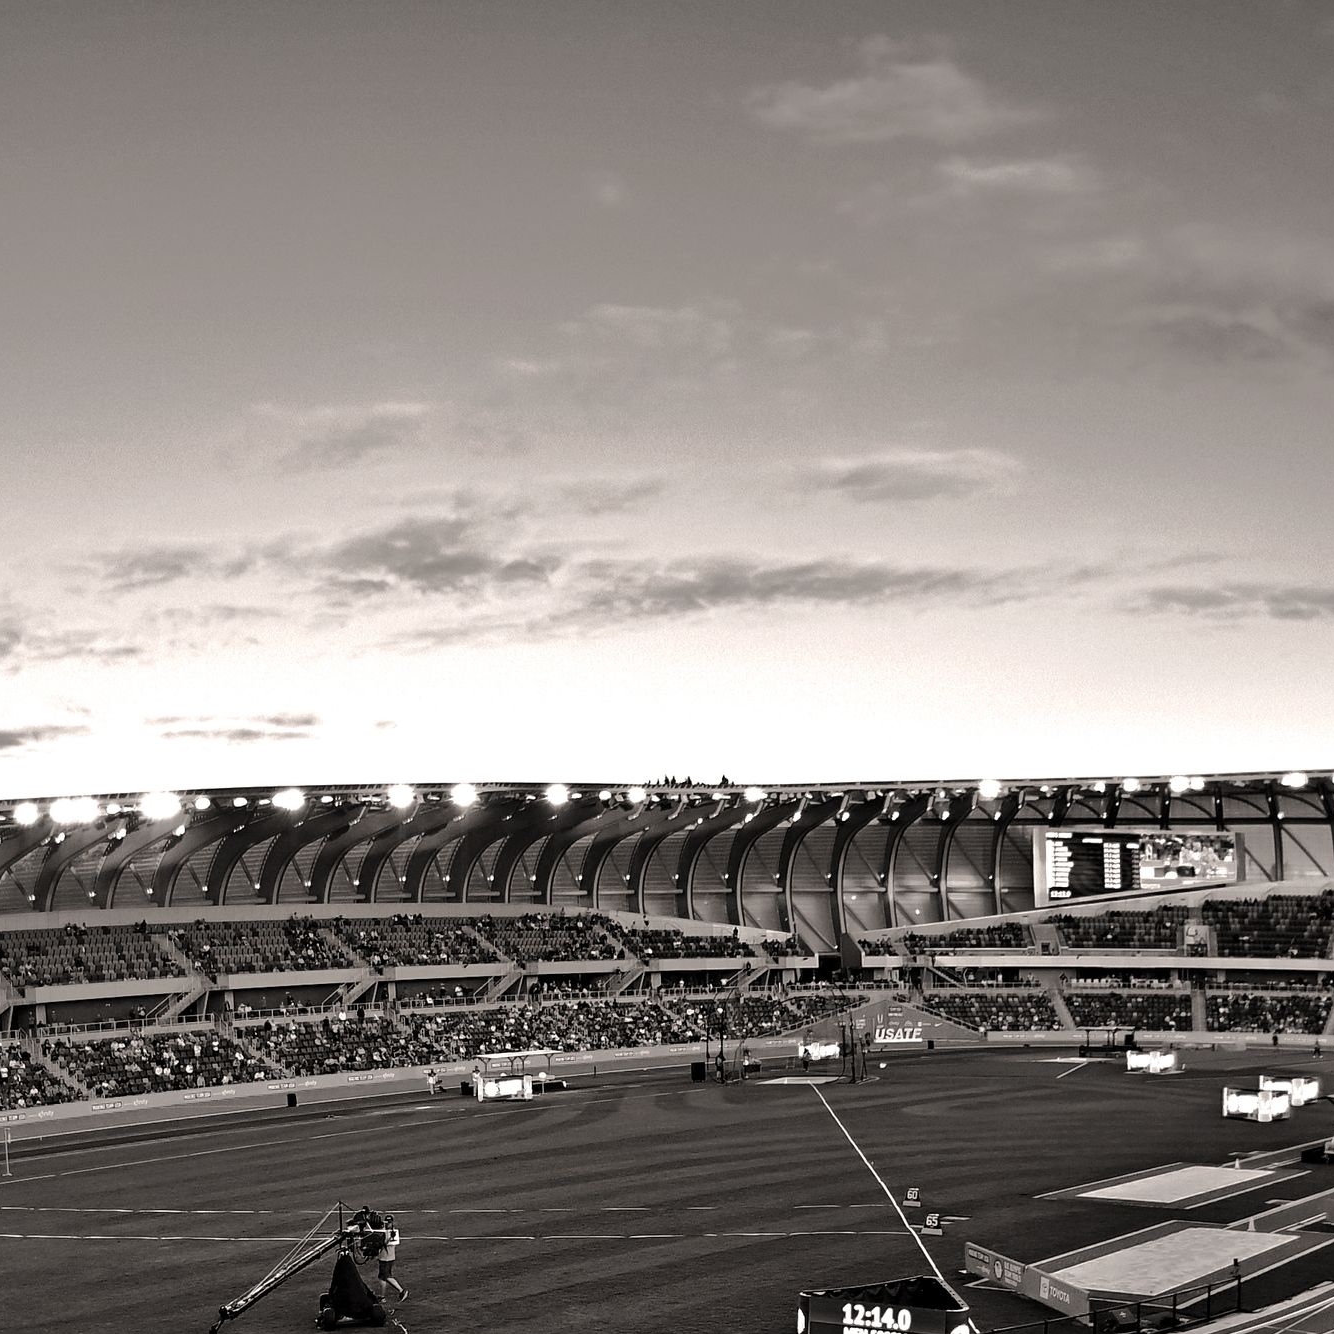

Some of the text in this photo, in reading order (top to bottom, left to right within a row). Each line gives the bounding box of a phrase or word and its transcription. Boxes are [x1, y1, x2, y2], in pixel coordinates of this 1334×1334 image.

[907, 1190, 918, 1200] 60
[926, 1216, 938, 1226] 65
[1049, 1286, 1070, 1304] TOYOTA
[842, 1303, 912, 1331] 12:14.0
